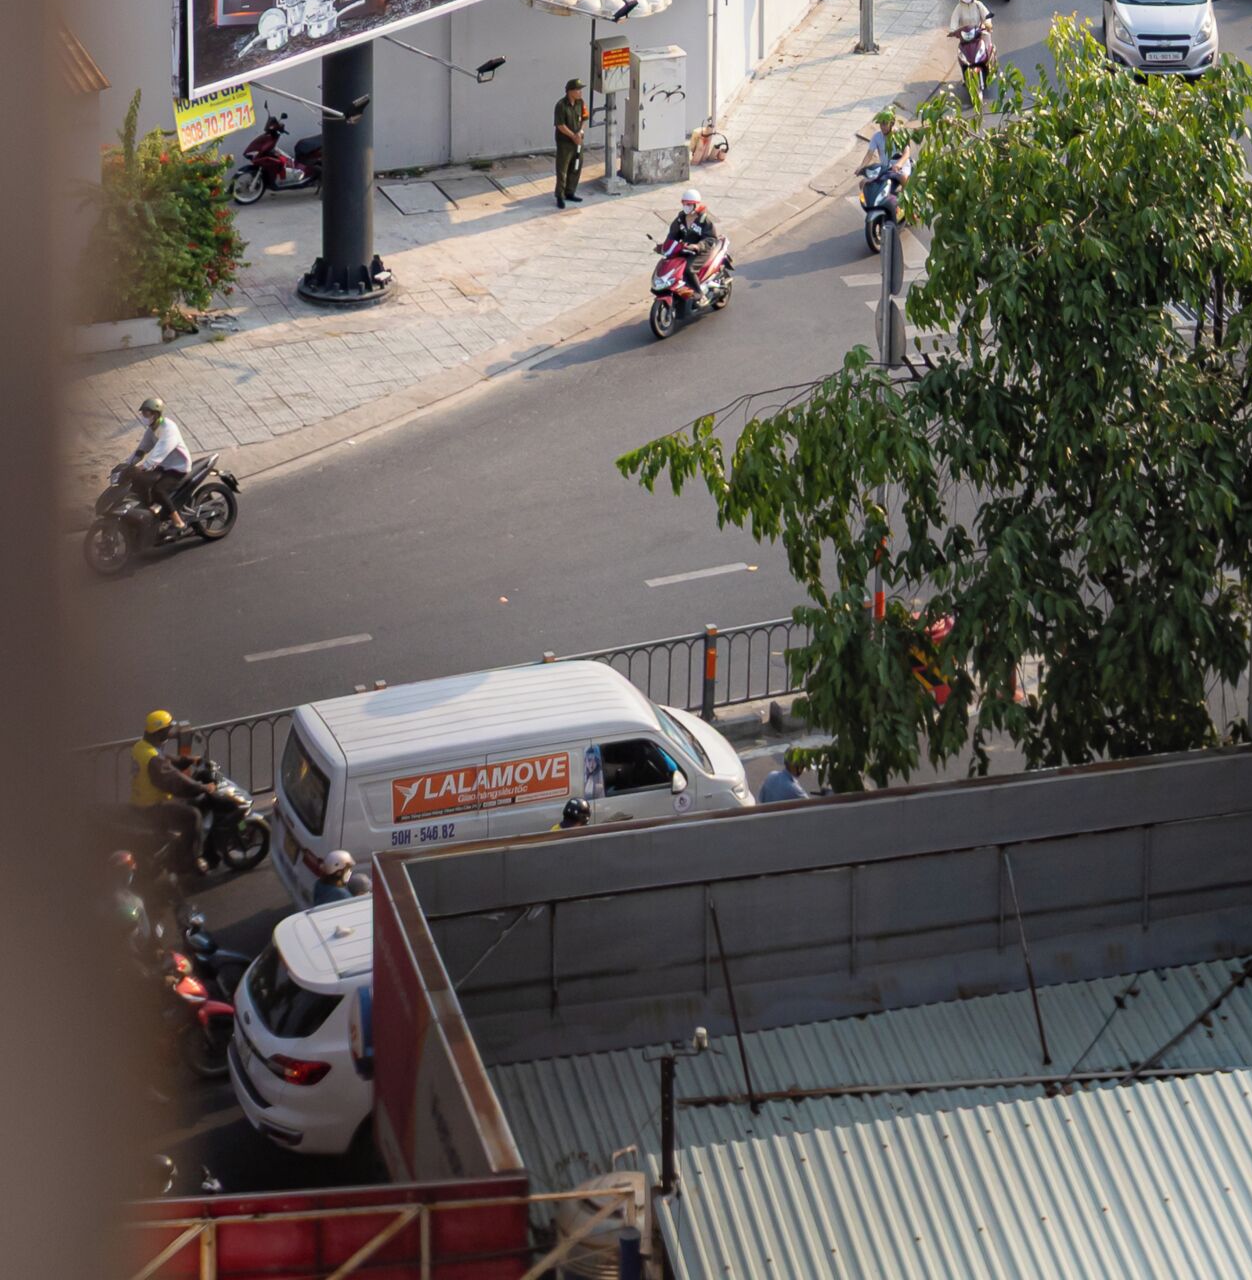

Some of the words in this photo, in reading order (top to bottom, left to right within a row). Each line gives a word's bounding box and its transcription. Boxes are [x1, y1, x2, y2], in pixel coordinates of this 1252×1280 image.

[424, 755, 567, 800] LALAMOVE
[391, 829, 412, 846] 50H
[420, 823, 455, 842] 546.82
